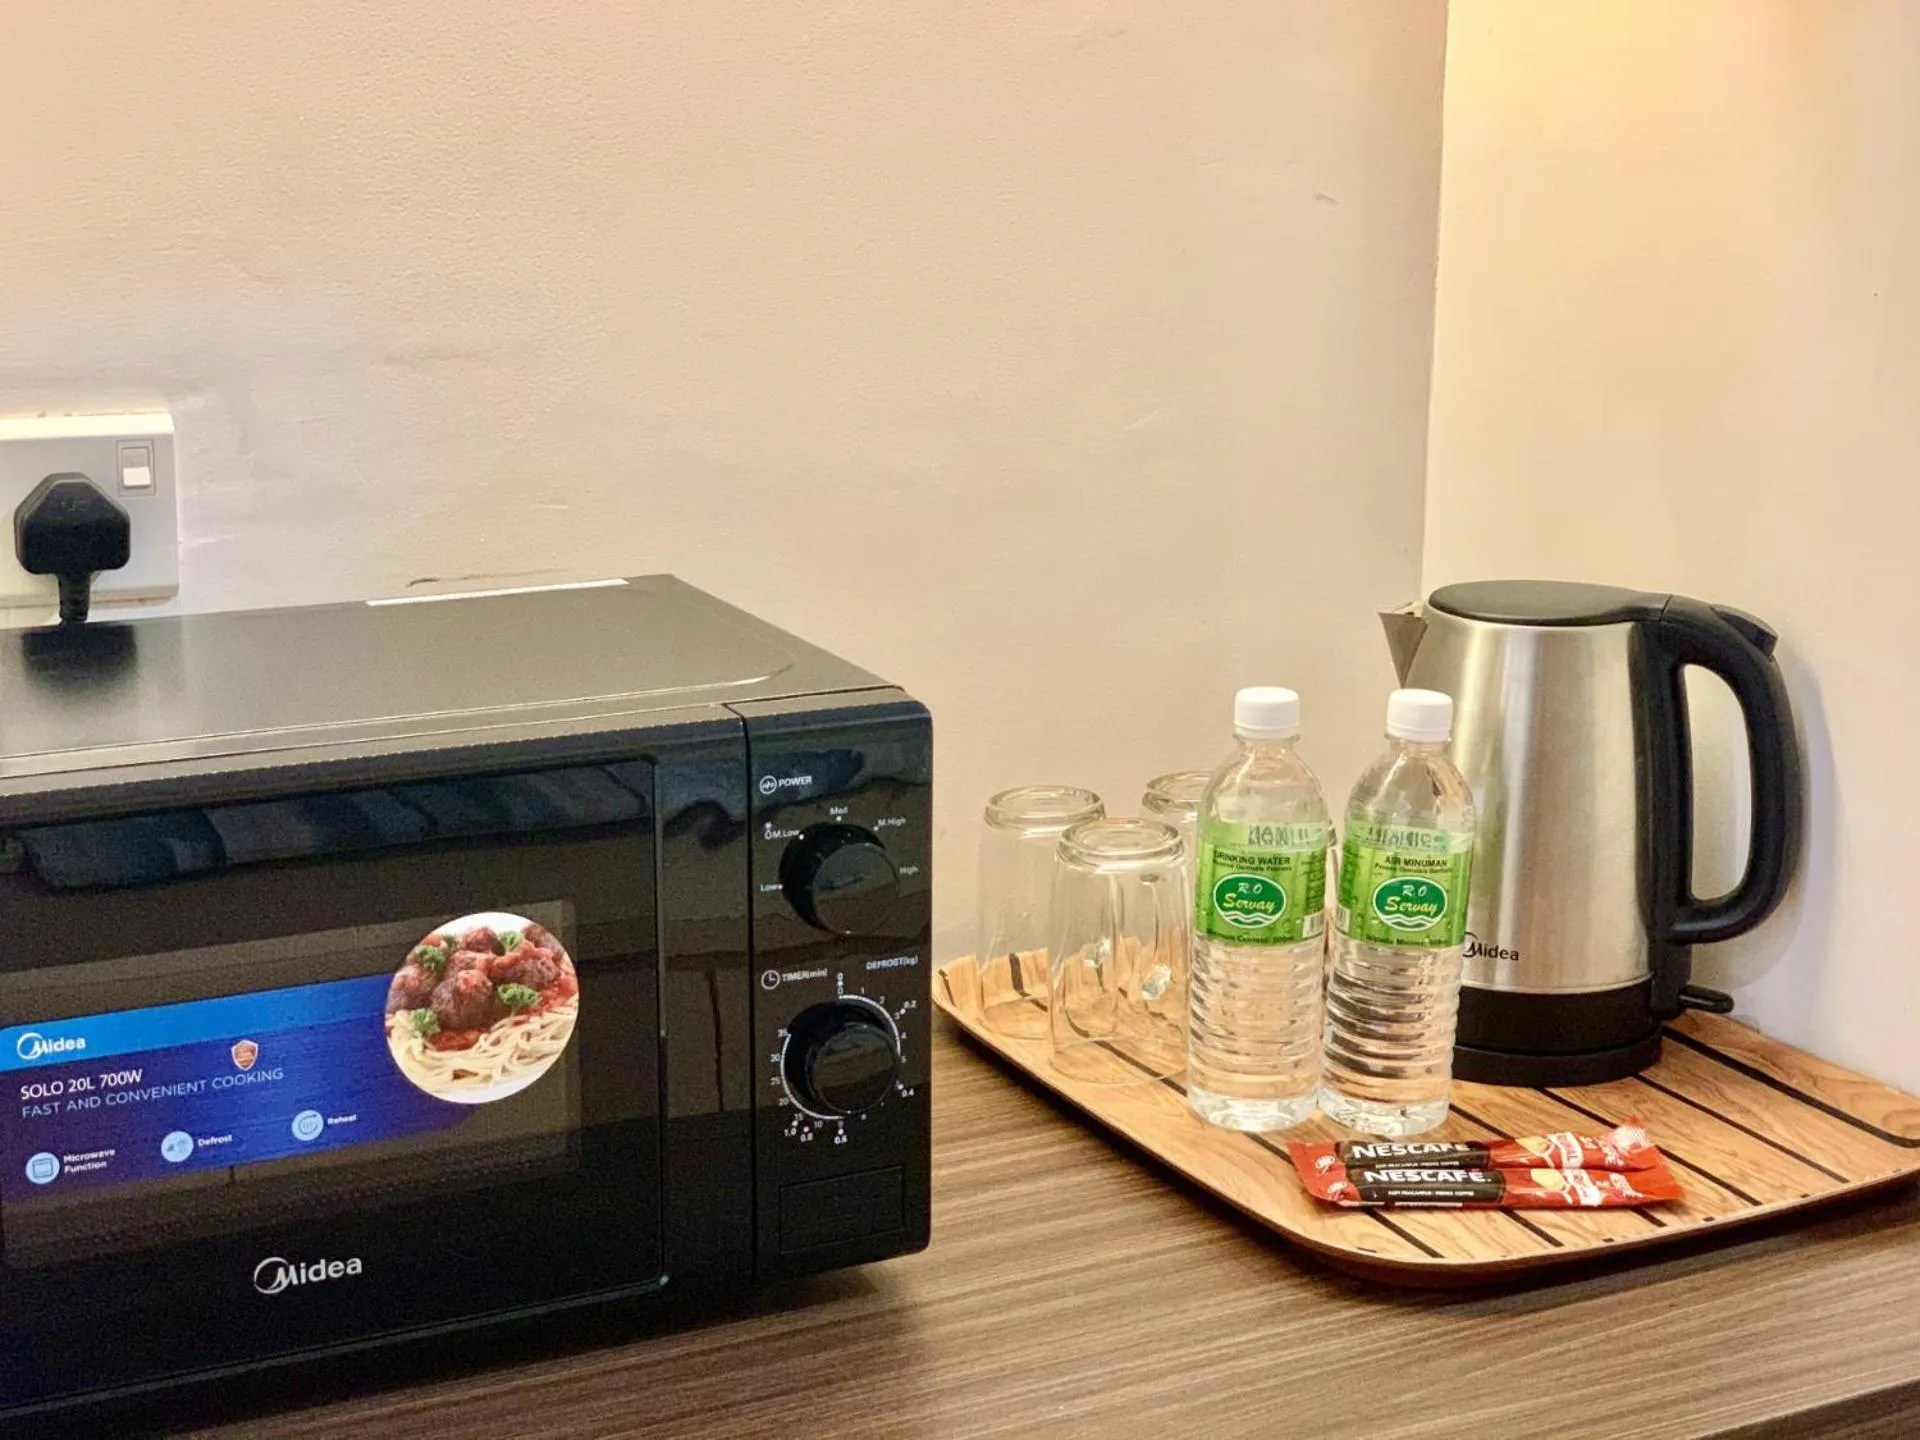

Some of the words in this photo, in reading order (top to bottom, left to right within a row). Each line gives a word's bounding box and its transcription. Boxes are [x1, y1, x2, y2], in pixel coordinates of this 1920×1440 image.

[778, 775, 813, 788] POWER
[772, 829, 801, 839] M.Low
[1213, 849, 1256, 865] DRINKING
[1257, 856, 1292, 866] WATER
[1403, 858, 1448, 868] MINUMAN
[1384, 896, 1438, 916] Servay
[1462, 931, 1519, 962] Midea
[17, 1031, 86, 1061] Midea
[20, 1079, 64, 1101] SOLO
[67, 1077, 96, 1094] 20L
[100, 1069, 143, 1088] 700W
[22, 1103, 60, 1121] FAST
[66, 1095, 102, 1113] AND
[105, 1079, 208, 1107] CONVENIENT
[212, 1067, 284, 1090] COOKING
[198, 1133, 234, 1147] Defrost
[63, 1148, 116, 1164] Microwave
[64, 1160, 107, 1175] Function
[254, 1256, 363, 1295] Midea
